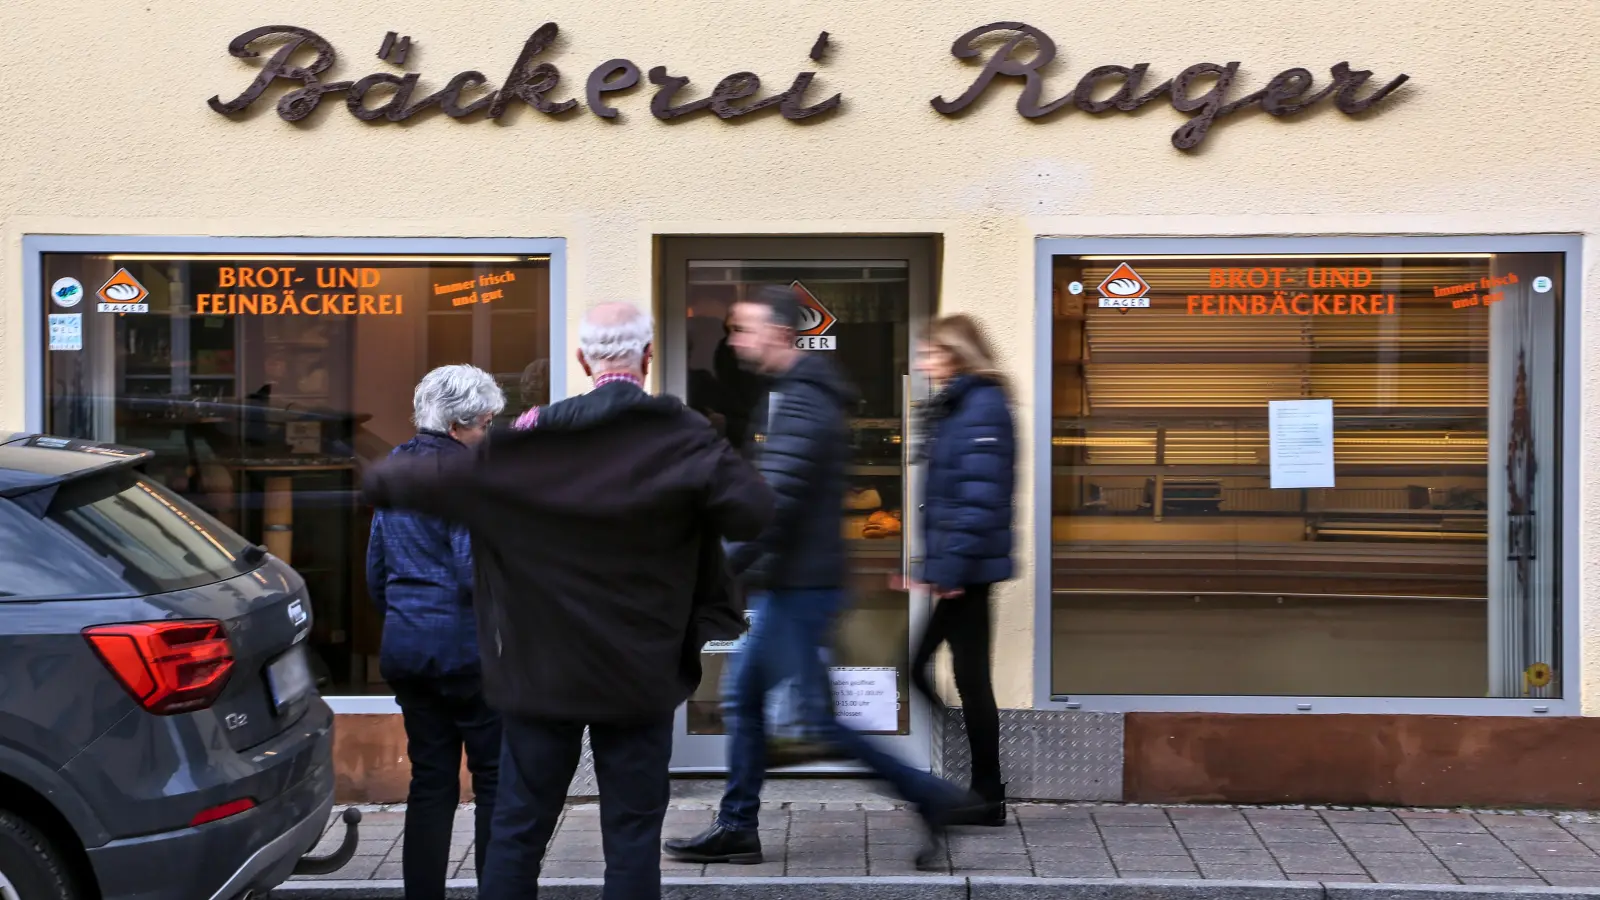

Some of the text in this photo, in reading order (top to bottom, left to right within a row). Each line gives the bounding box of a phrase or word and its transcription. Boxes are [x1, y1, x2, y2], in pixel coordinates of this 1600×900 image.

[207, 21, 842, 122] Bäckerei
[930, 21, 1410, 152] Rager
[218, 266, 381, 288] BROT- UND
[433, 270, 516, 295] immer frisch
[1209, 267, 1372, 288] BROT- UND
[1433, 272, 1520, 298] immer frisch
[103, 303, 145, 313] RAGER
[196, 289, 403, 315] FEINBÄCKEREI
[451, 289, 503, 307] und gut
[1103, 298, 1145, 307] RAGER
[1186, 290, 1396, 315] FEINBÄCKEREI
[1452, 291, 1505, 309] und gut
[794, 337, 830, 349] GER
